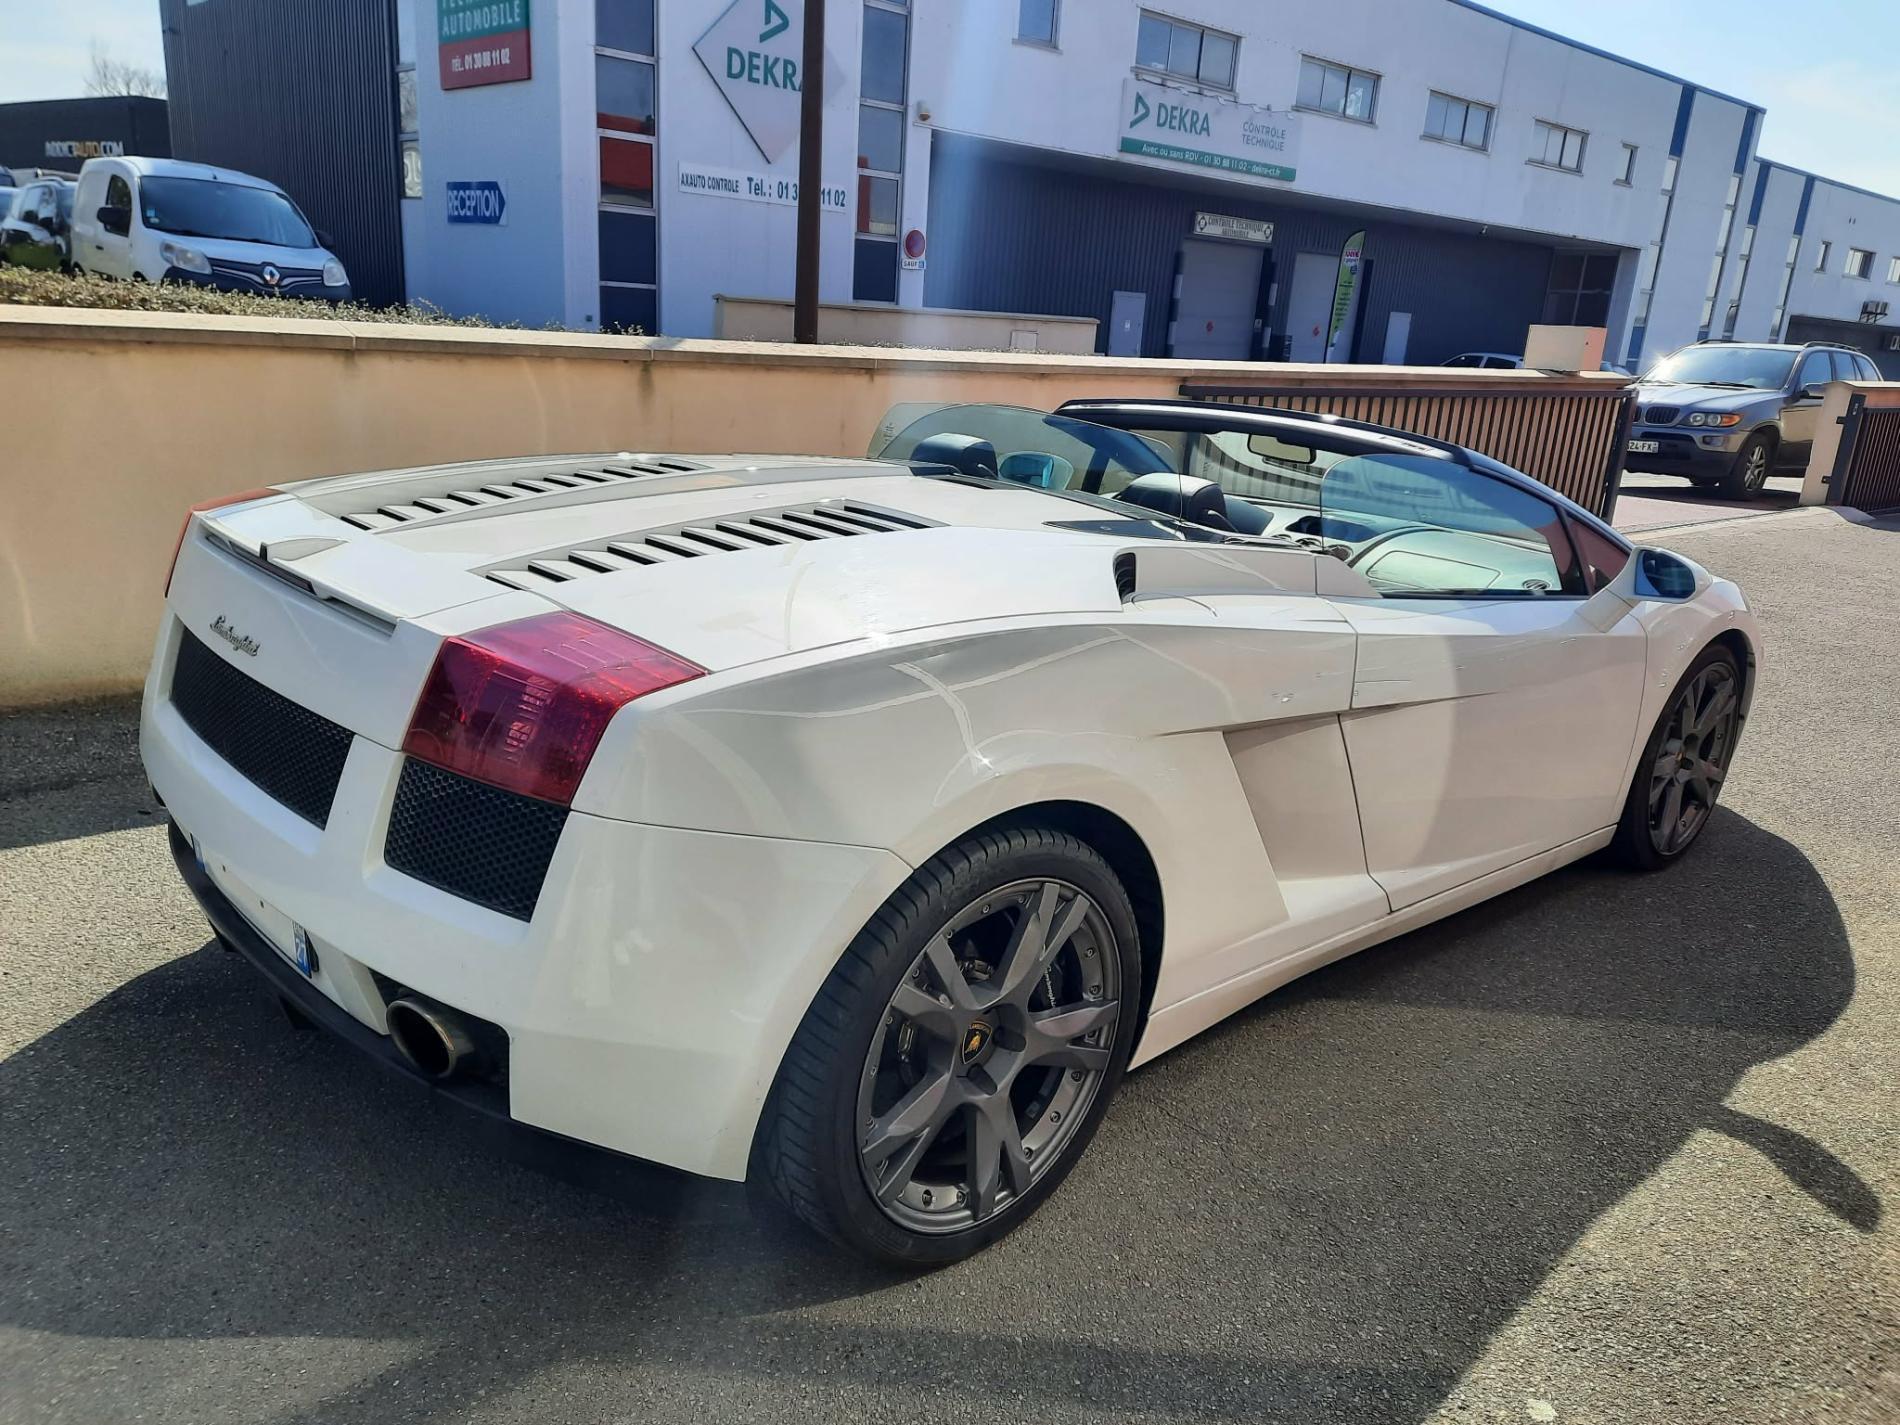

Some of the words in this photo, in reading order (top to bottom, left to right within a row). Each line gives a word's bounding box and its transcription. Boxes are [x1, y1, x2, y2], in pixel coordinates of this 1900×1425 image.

[442, 0, 520, 36] AUTOMOBILE
[726, 46, 802, 92] DEKR
[1156, 102, 1210, 137] DEKRA
[1142, 143, 1158, 155] Avec
[1185, 151, 1199, 161] RDV
[1242, 134, 1284, 151] TECHNIQUE
[447, 189, 499, 217] RECEPTION
[681, 173, 706, 189] AXAUTO
[707, 177, 739, 193] CONTROLE
[777, 181, 789, 200] 01
[834, 189, 846, 208] 02
